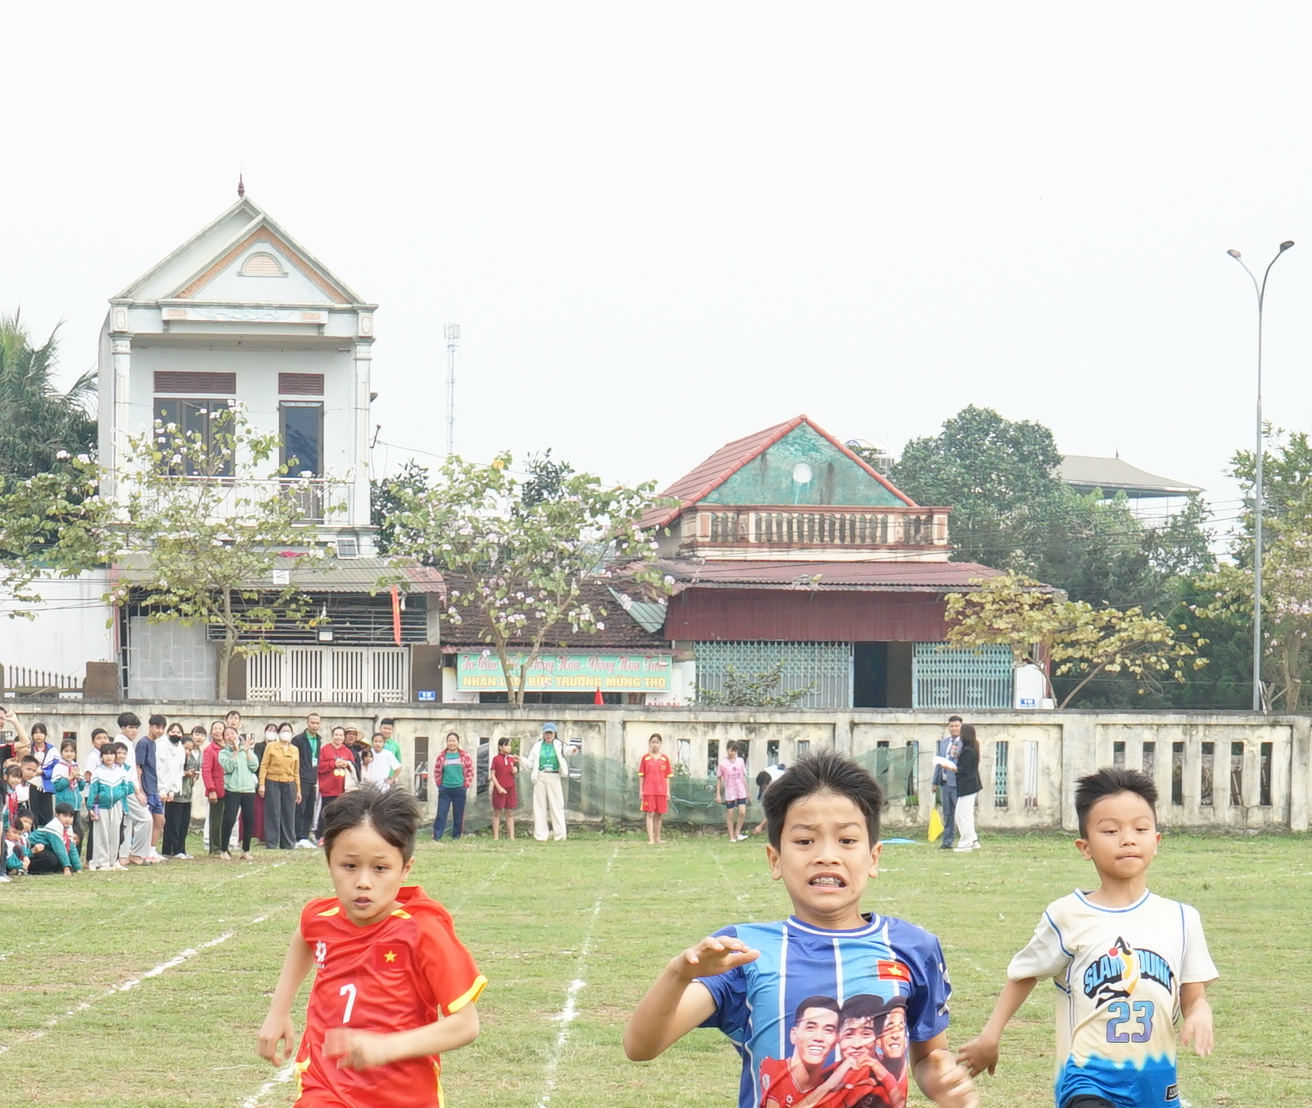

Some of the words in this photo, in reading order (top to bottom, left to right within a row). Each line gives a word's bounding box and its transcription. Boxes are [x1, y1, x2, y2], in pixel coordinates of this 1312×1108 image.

[463, 674, 497, 690] NHẬN
[643, 676, 666, 690] THỌ
[1083, 953, 1126, 998] SLAM
[339, 983, 357, 1024] 7
[1106, 1000, 1155, 1043] 23
